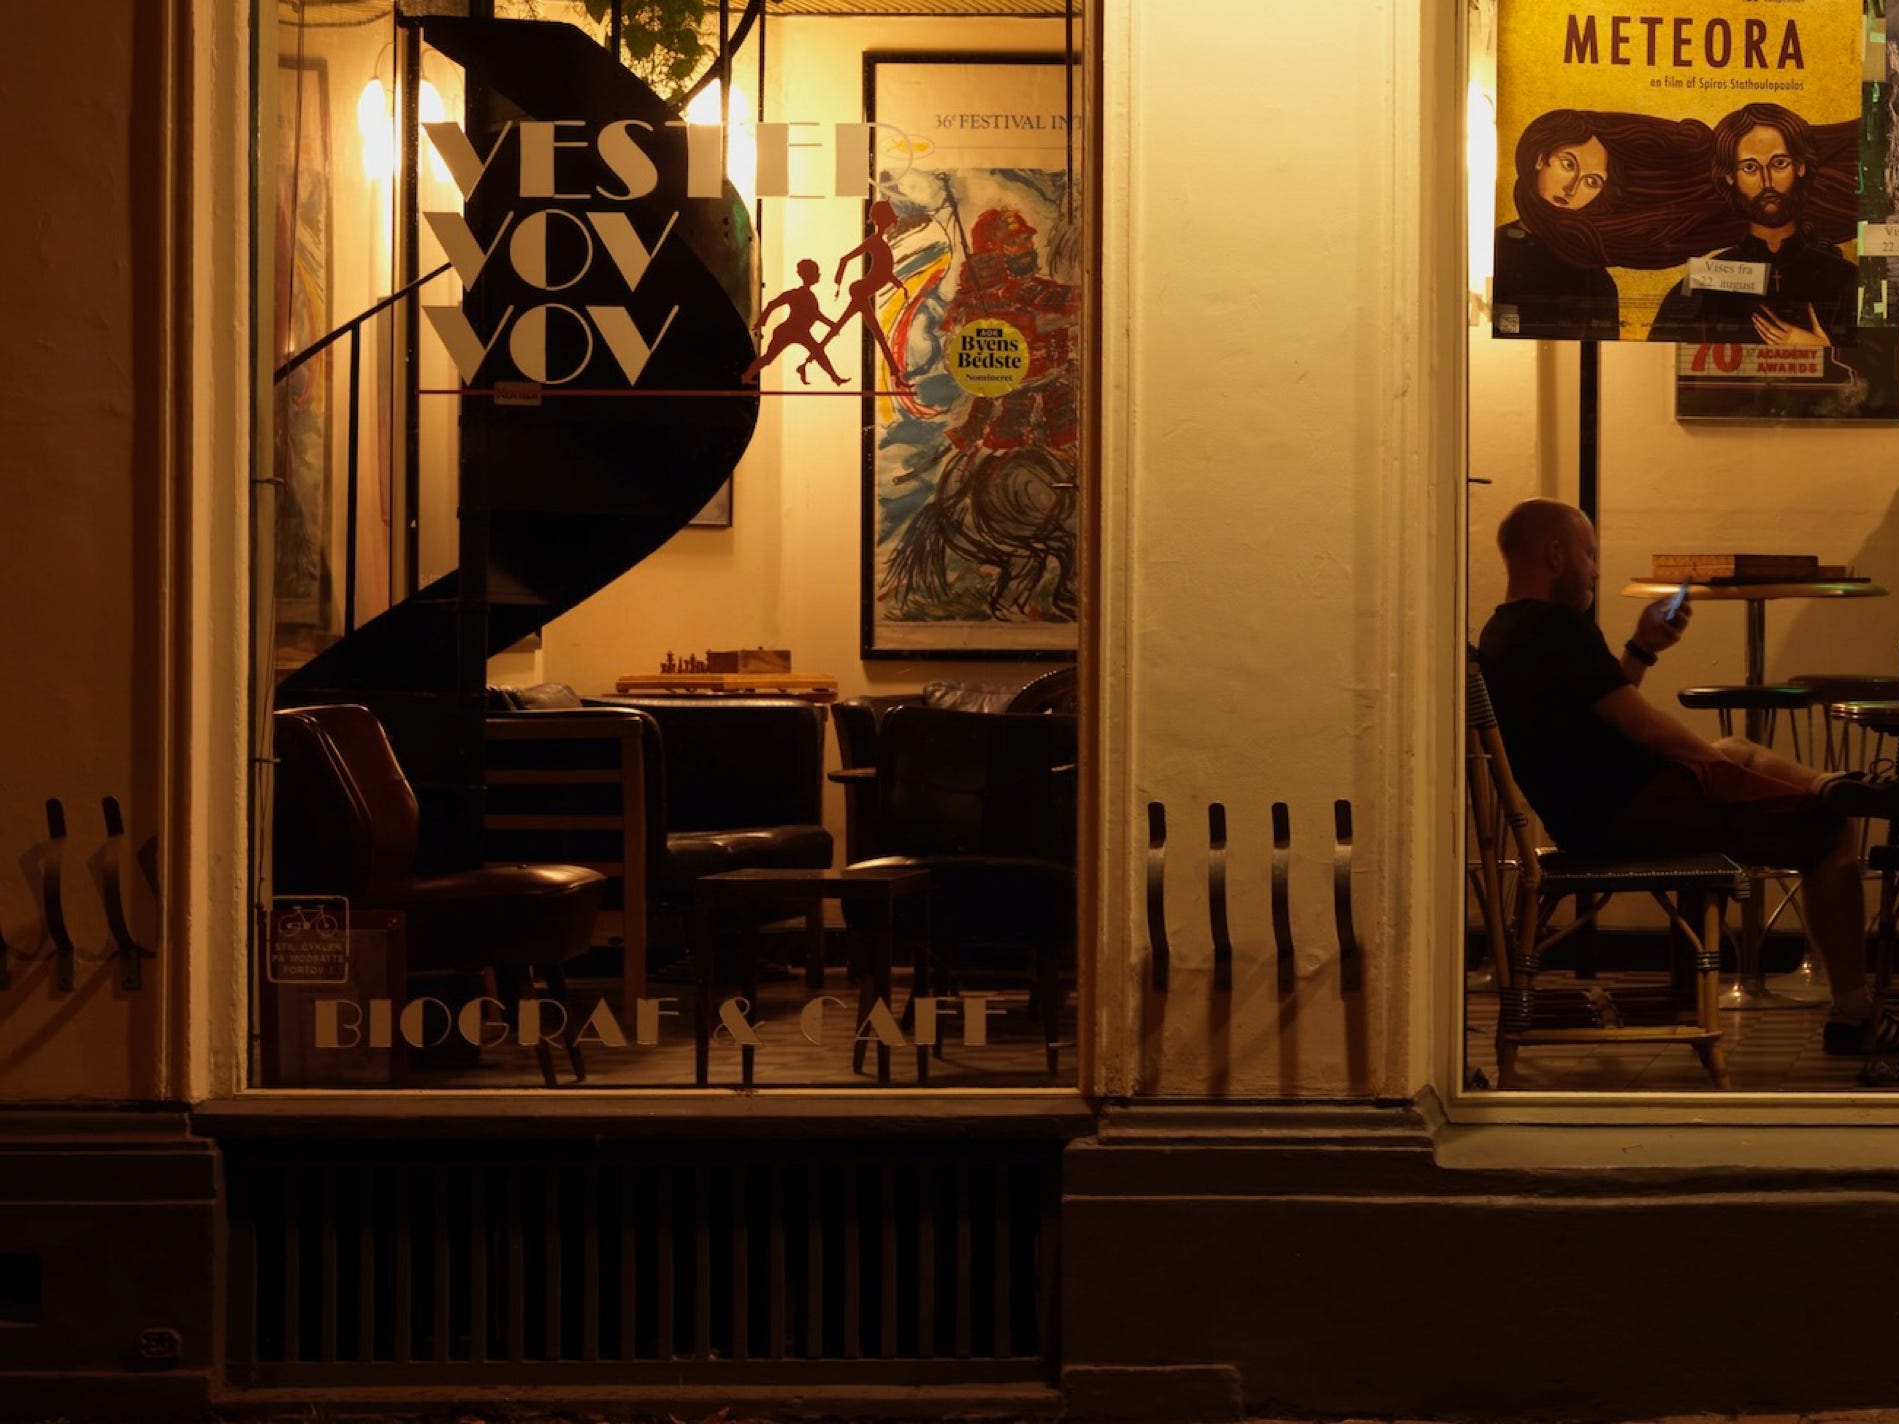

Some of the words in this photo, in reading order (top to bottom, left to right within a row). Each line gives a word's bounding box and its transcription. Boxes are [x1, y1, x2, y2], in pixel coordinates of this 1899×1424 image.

[1563, 14, 1806, 71] METEORA
[1650, 78, 1662, 88] en
[1664, 76, 1683, 89] film
[1686, 78, 1697, 89] af
[1699, 77, 1728, 91] Spiros
[959, 114, 1048, 131] FESTIVAL
[420, 119, 914, 202] VESTER
[420, 208, 681, 293] VOV
[1705, 260, 1735, 274] Vises
[1738, 263, 1753, 275] fra
[1719, 279, 1756, 292] august
[420, 302, 681, 386] VOV
[961, 335, 1018, 355] Byens
[957, 351, 1022, 369] Bedste
[1757, 348, 1818, 360] ACADEMY
[1757, 362, 1817, 374] AWARDS
[314, 996, 681, 1049] BIOGRAF
[713, 995, 766, 1047] &
